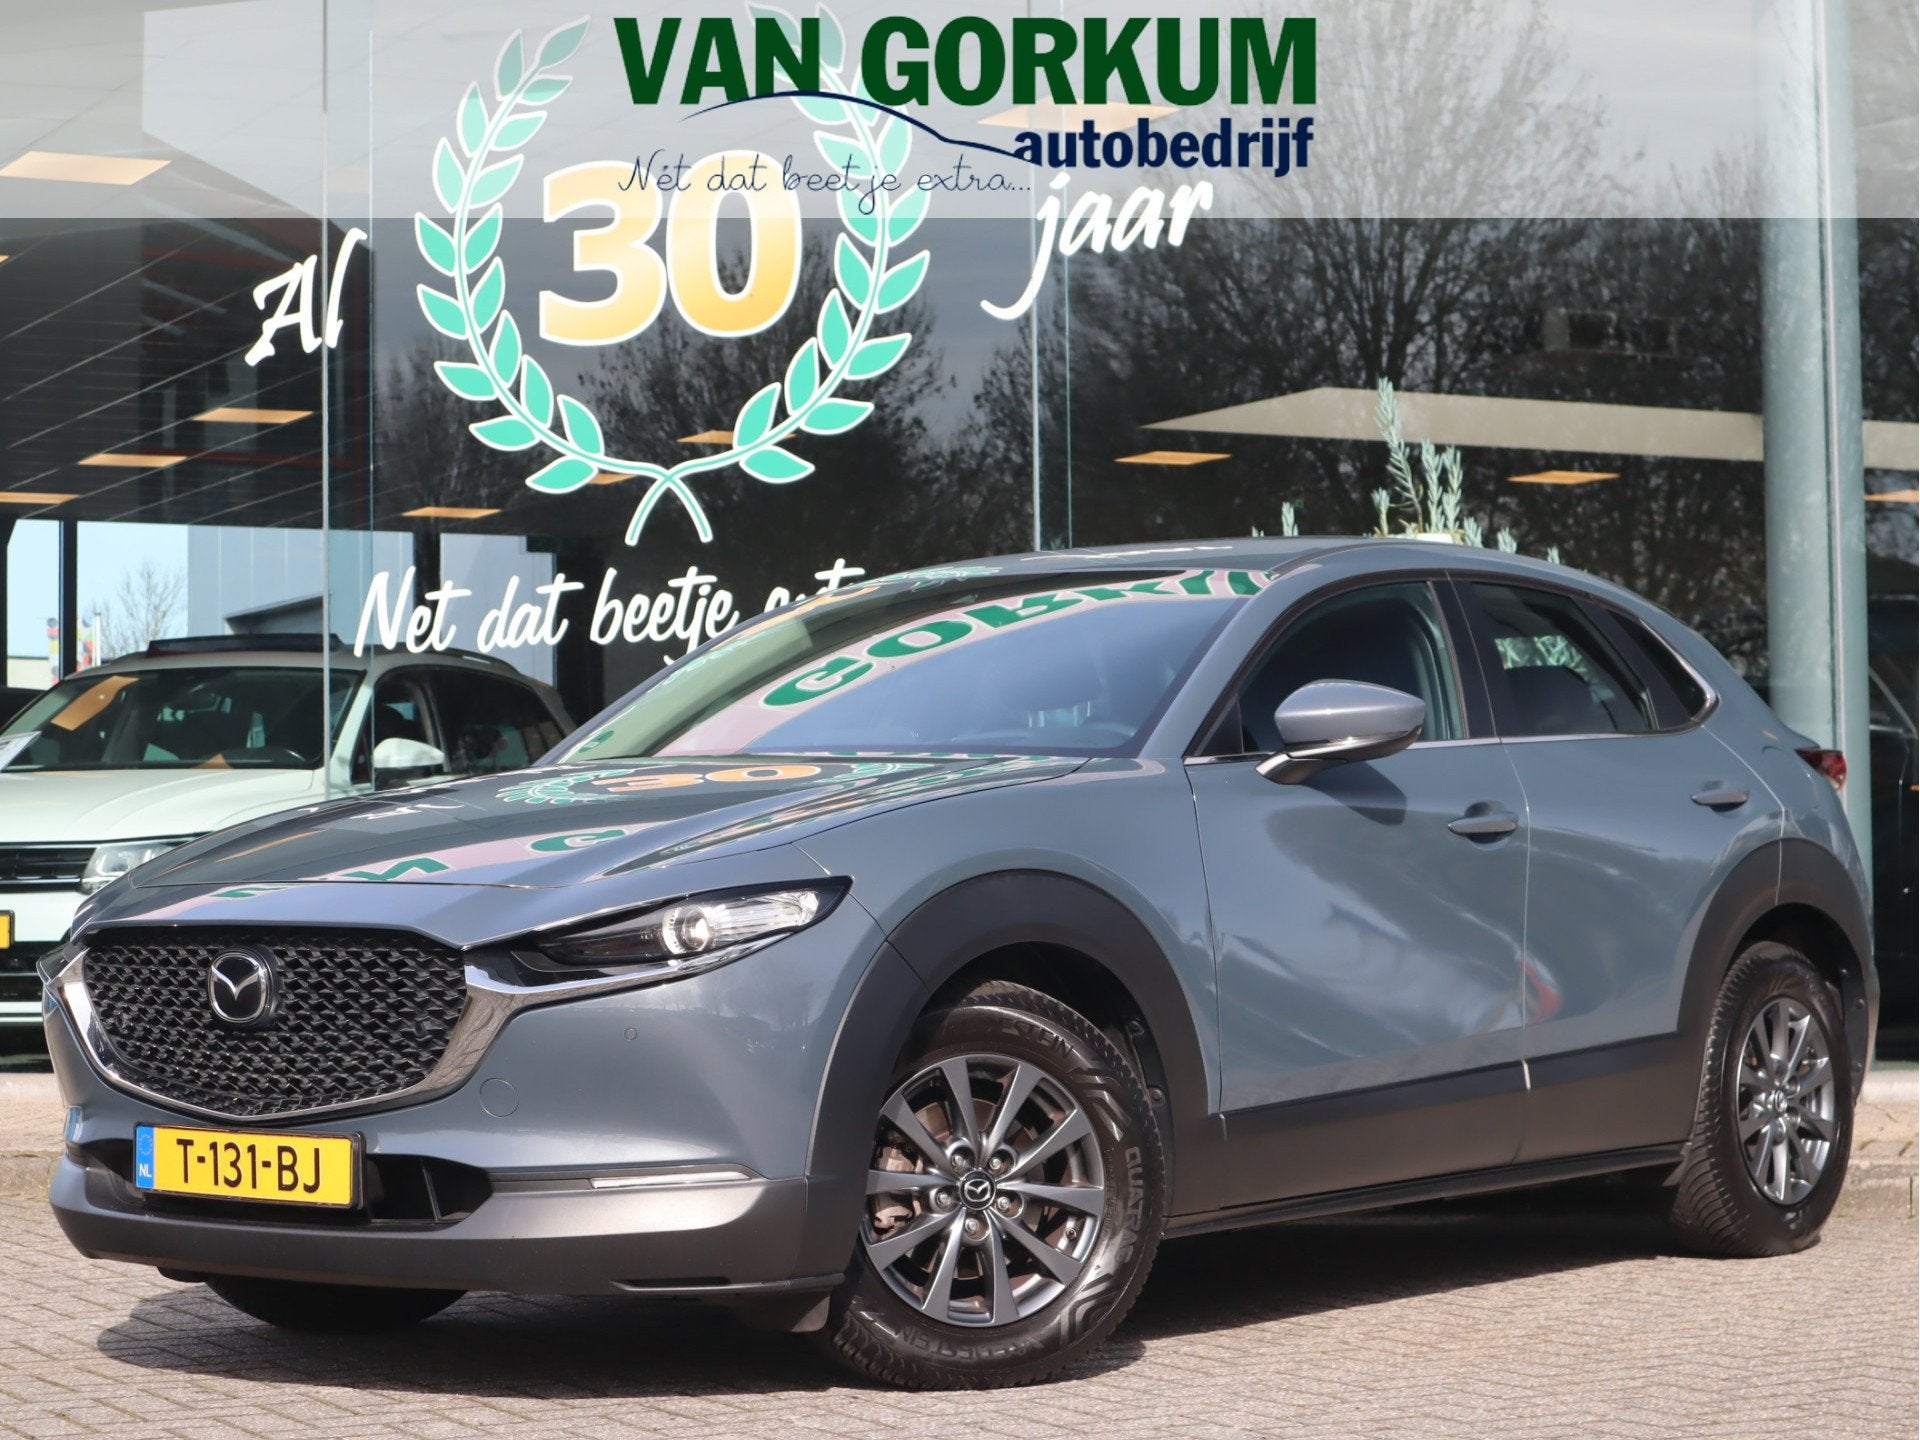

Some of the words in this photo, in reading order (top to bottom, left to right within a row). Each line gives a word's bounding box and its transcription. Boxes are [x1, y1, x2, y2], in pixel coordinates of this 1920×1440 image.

[244, 227, 368, 366] Al
[540, 150, 802, 346] 30
[980, 171, 1213, 320] jaar
[354, 565, 472, 658] Net
[477, 573, 584, 653] dat
[590, 565, 740, 666] beetje
[139, 1163, 152, 1178] NL
[176, 1138, 321, 1194] T-131-BJ
